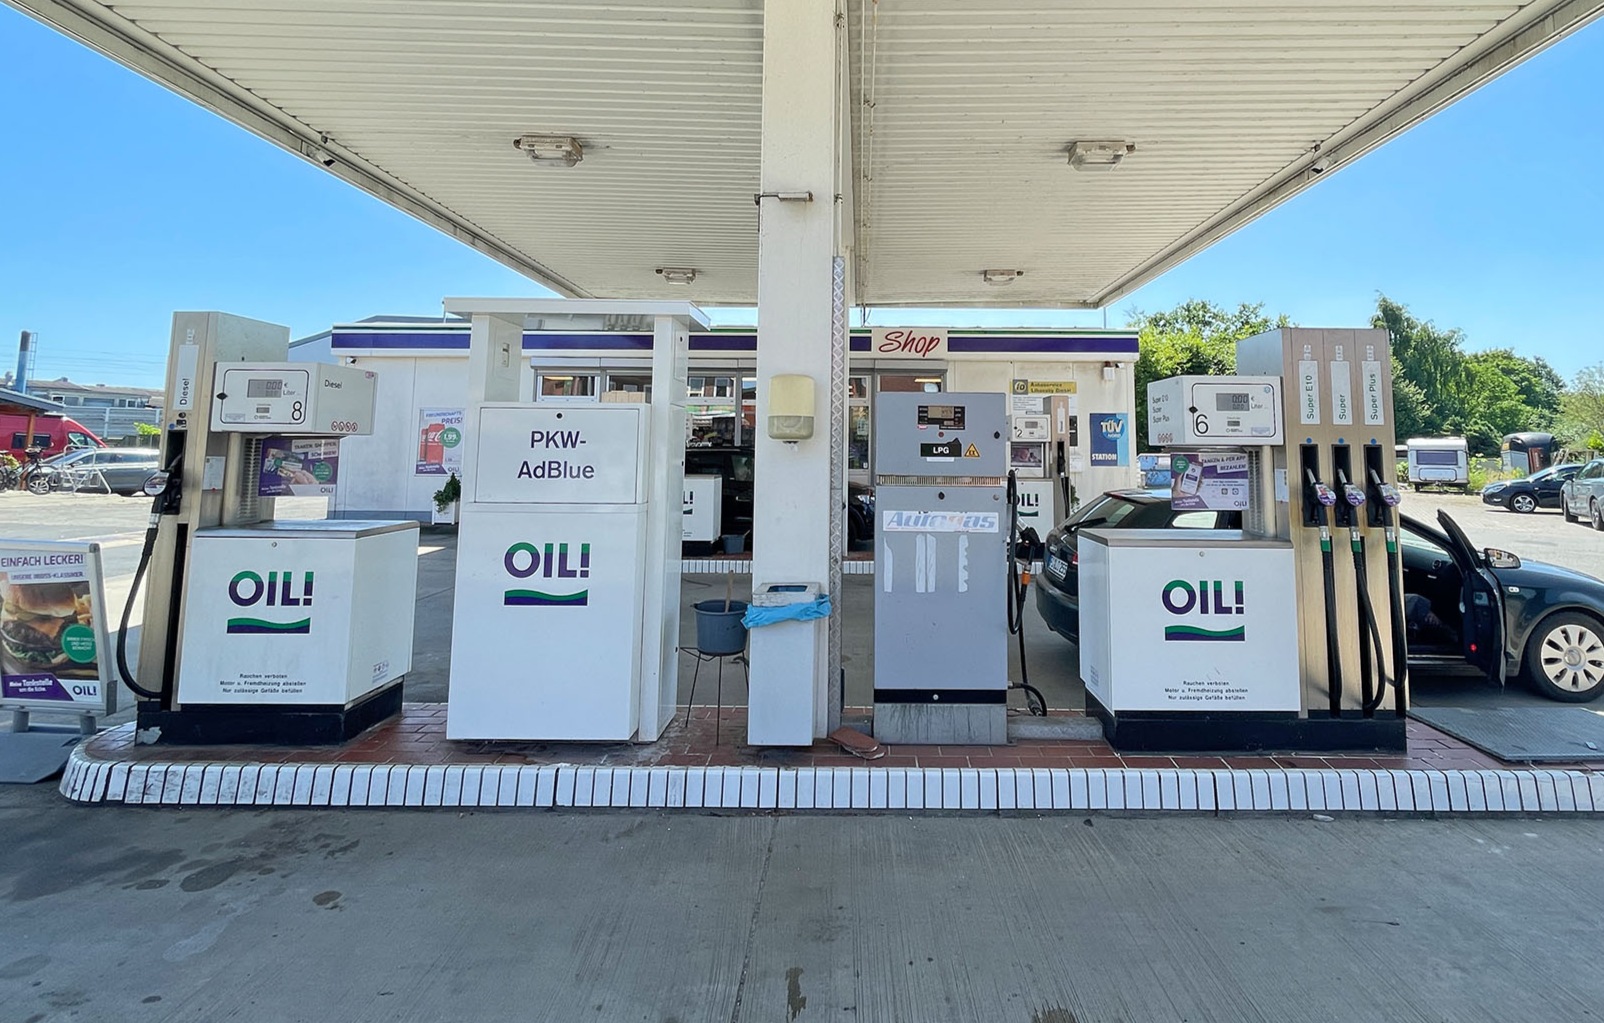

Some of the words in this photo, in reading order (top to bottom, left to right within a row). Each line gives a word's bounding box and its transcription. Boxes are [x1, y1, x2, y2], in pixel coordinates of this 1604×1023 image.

[879, 330, 940, 357] Shop
[180, 378, 190, 405] Diesel
[325, 379, 342, 389] Diesel
[292, 401, 302, 421] 8
[1306, 394, 1314, 419] Super
[1338, 394, 1346, 420] Super
[1370, 395, 1378, 420] Super
[1017, 429, 1022, 438] 2
[1101, 418, 1123, 433] TÜV
[1196, 414, 1208, 434] 6
[531, 430, 587, 449] PKW-
[933, 446, 950, 454] LPG
[517, 460, 595, 479] AdBlue
[1, 556, 41, 567] EINFACH
[44, 554, 84, 565] LECKER!
[504, 542, 590, 578] OIL!
[228, 570, 314, 606] OIL!
[1162, 579, 1244, 615] OIL!
[73, 685, 97, 695] OIL!
